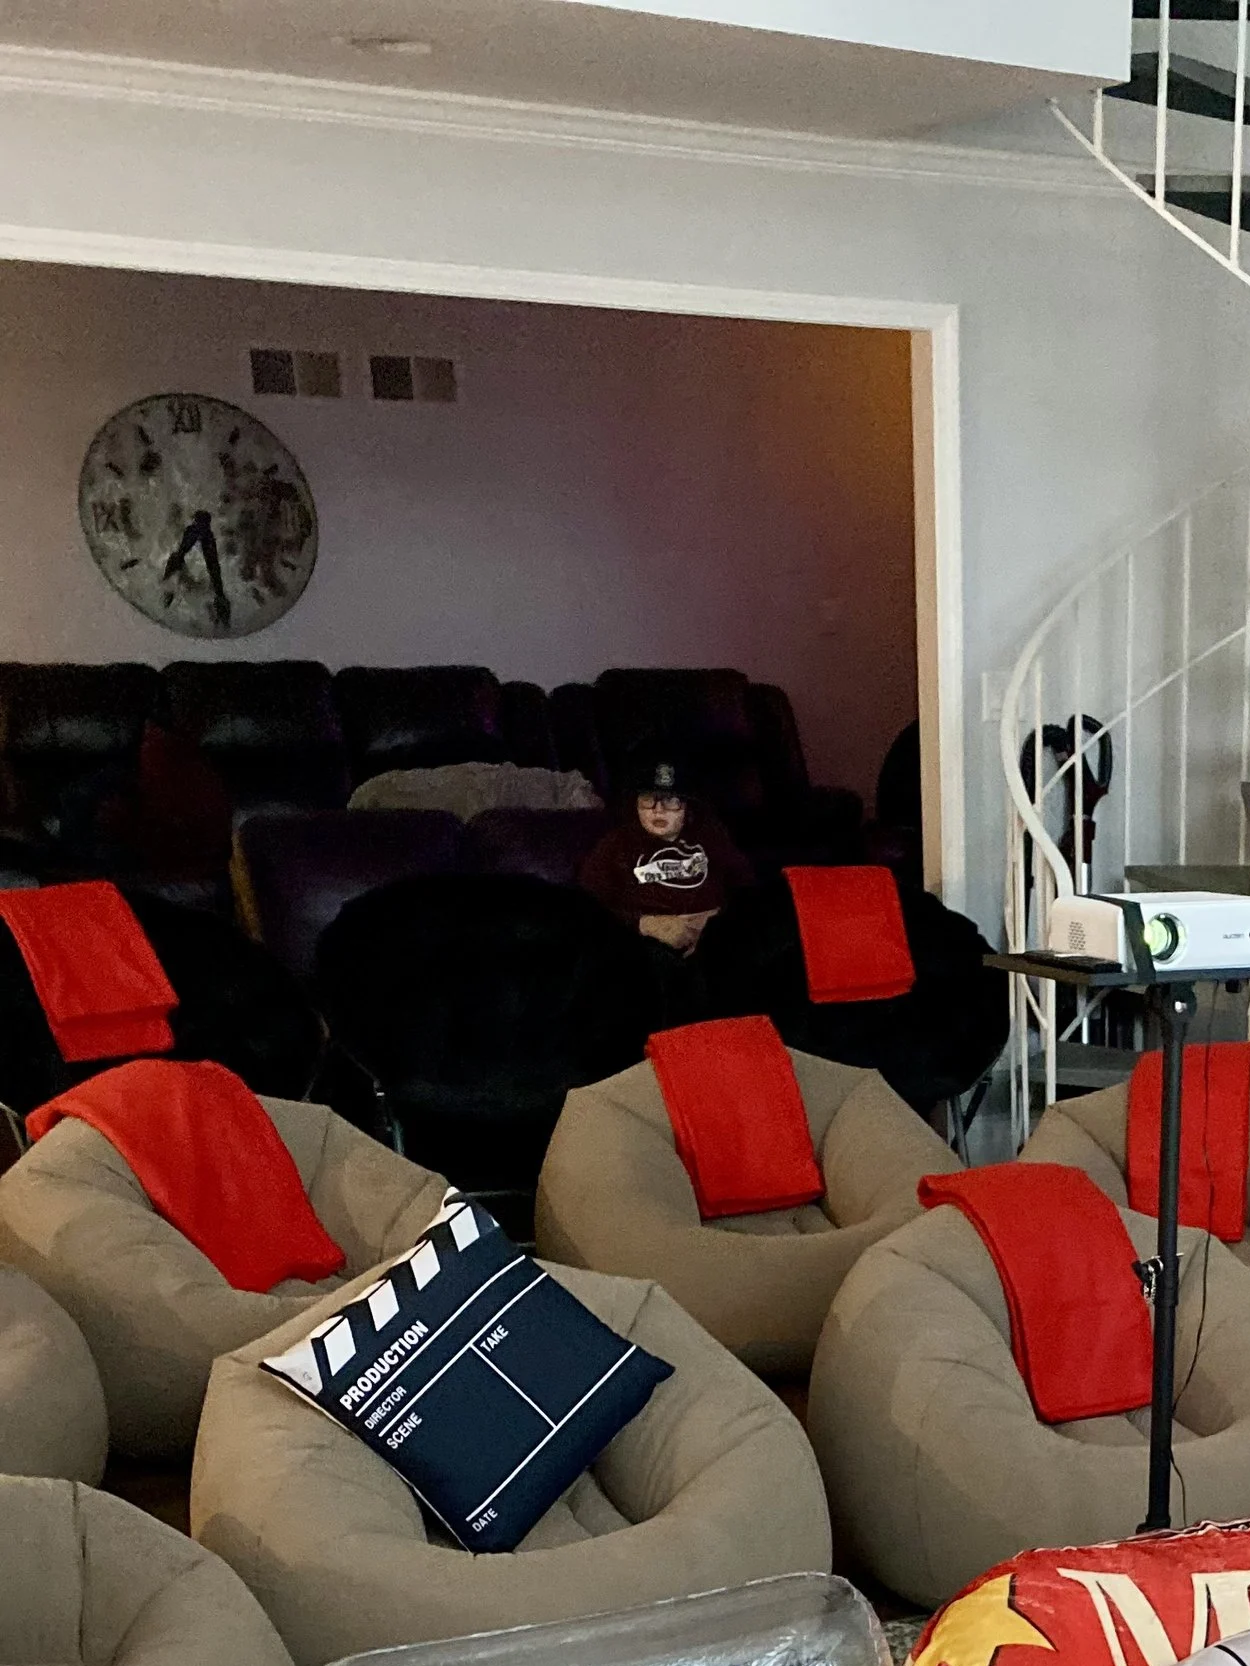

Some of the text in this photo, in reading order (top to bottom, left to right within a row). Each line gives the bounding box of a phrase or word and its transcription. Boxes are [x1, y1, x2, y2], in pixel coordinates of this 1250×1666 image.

[480, 1324, 509, 1353] TAKE
[338, 1320, 429, 1411] PRODUCTION
[364, 1385, 407, 1430] DIRECTOR
[386, 1412, 423, 1450] SCENE
[471, 1507, 499, 1533] DATE
